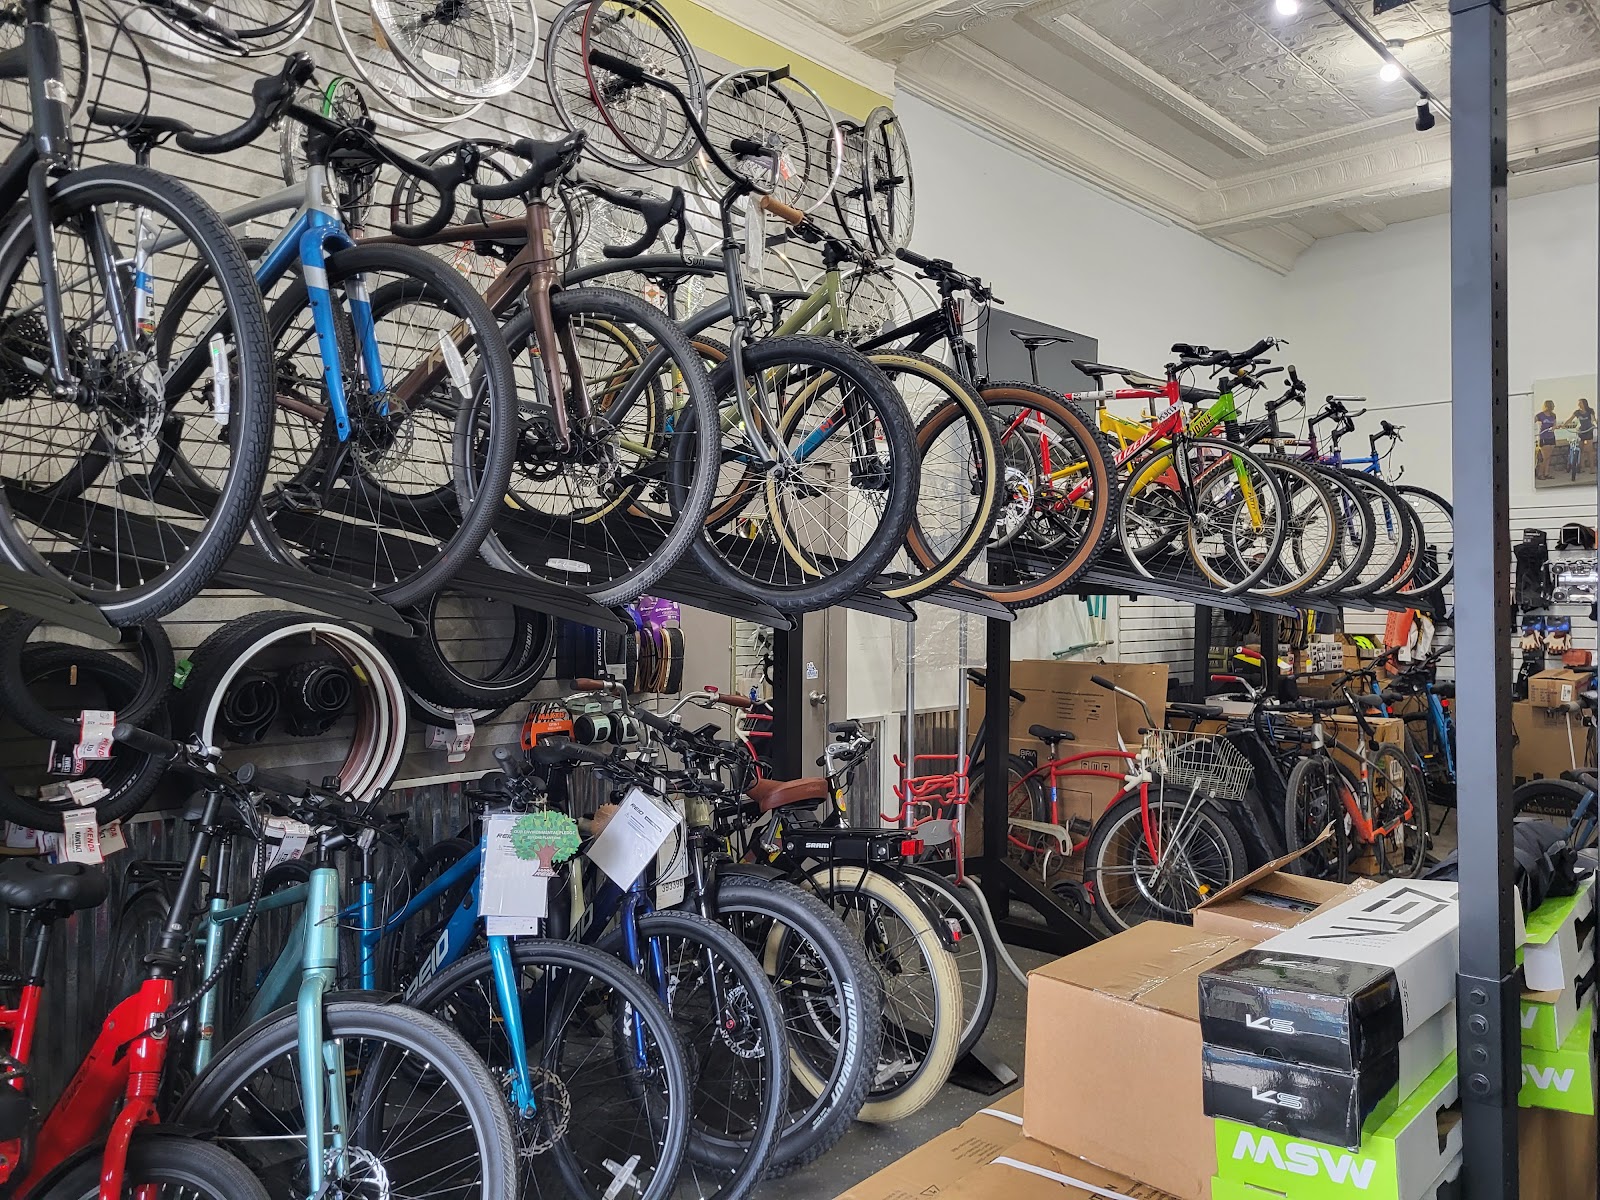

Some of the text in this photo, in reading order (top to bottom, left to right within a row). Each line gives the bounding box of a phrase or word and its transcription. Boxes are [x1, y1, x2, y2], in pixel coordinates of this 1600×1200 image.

[86, 826, 95, 852] KENDA
[1245, 1013, 1295, 1034] KS
[831, 998, 858, 1108] JUGGERNAUT
[1251, 1085, 1303, 1110] KS
[1231, 1130, 1377, 1190] MSW
